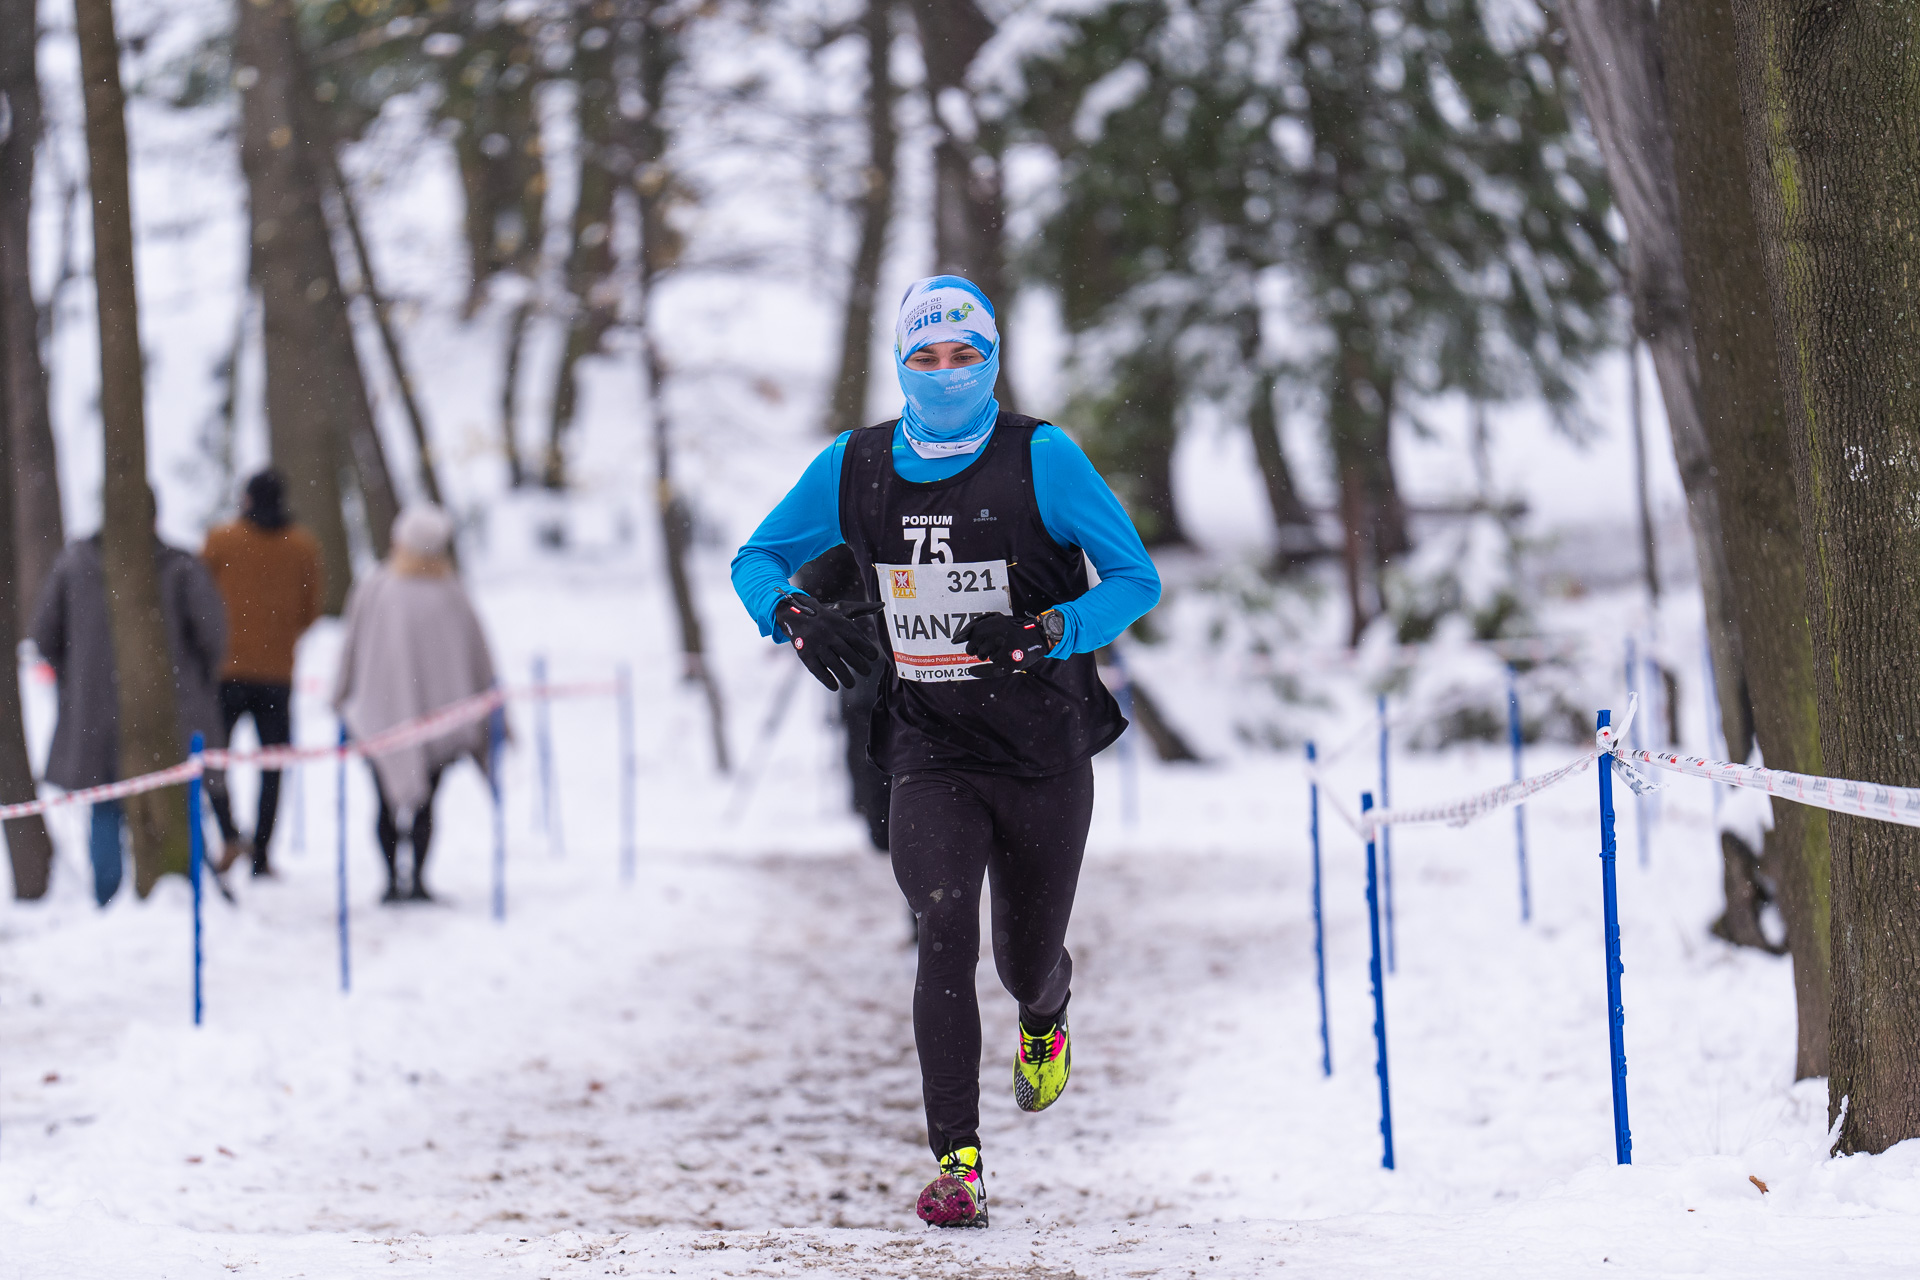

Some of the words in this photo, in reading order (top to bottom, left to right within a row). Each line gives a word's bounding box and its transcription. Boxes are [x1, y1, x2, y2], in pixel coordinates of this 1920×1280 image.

[901, 515, 953, 526] PODIUM
[903, 527, 954, 565] 75
[946, 568, 997, 593] 321
[914, 669, 955, 679] BYTOM
